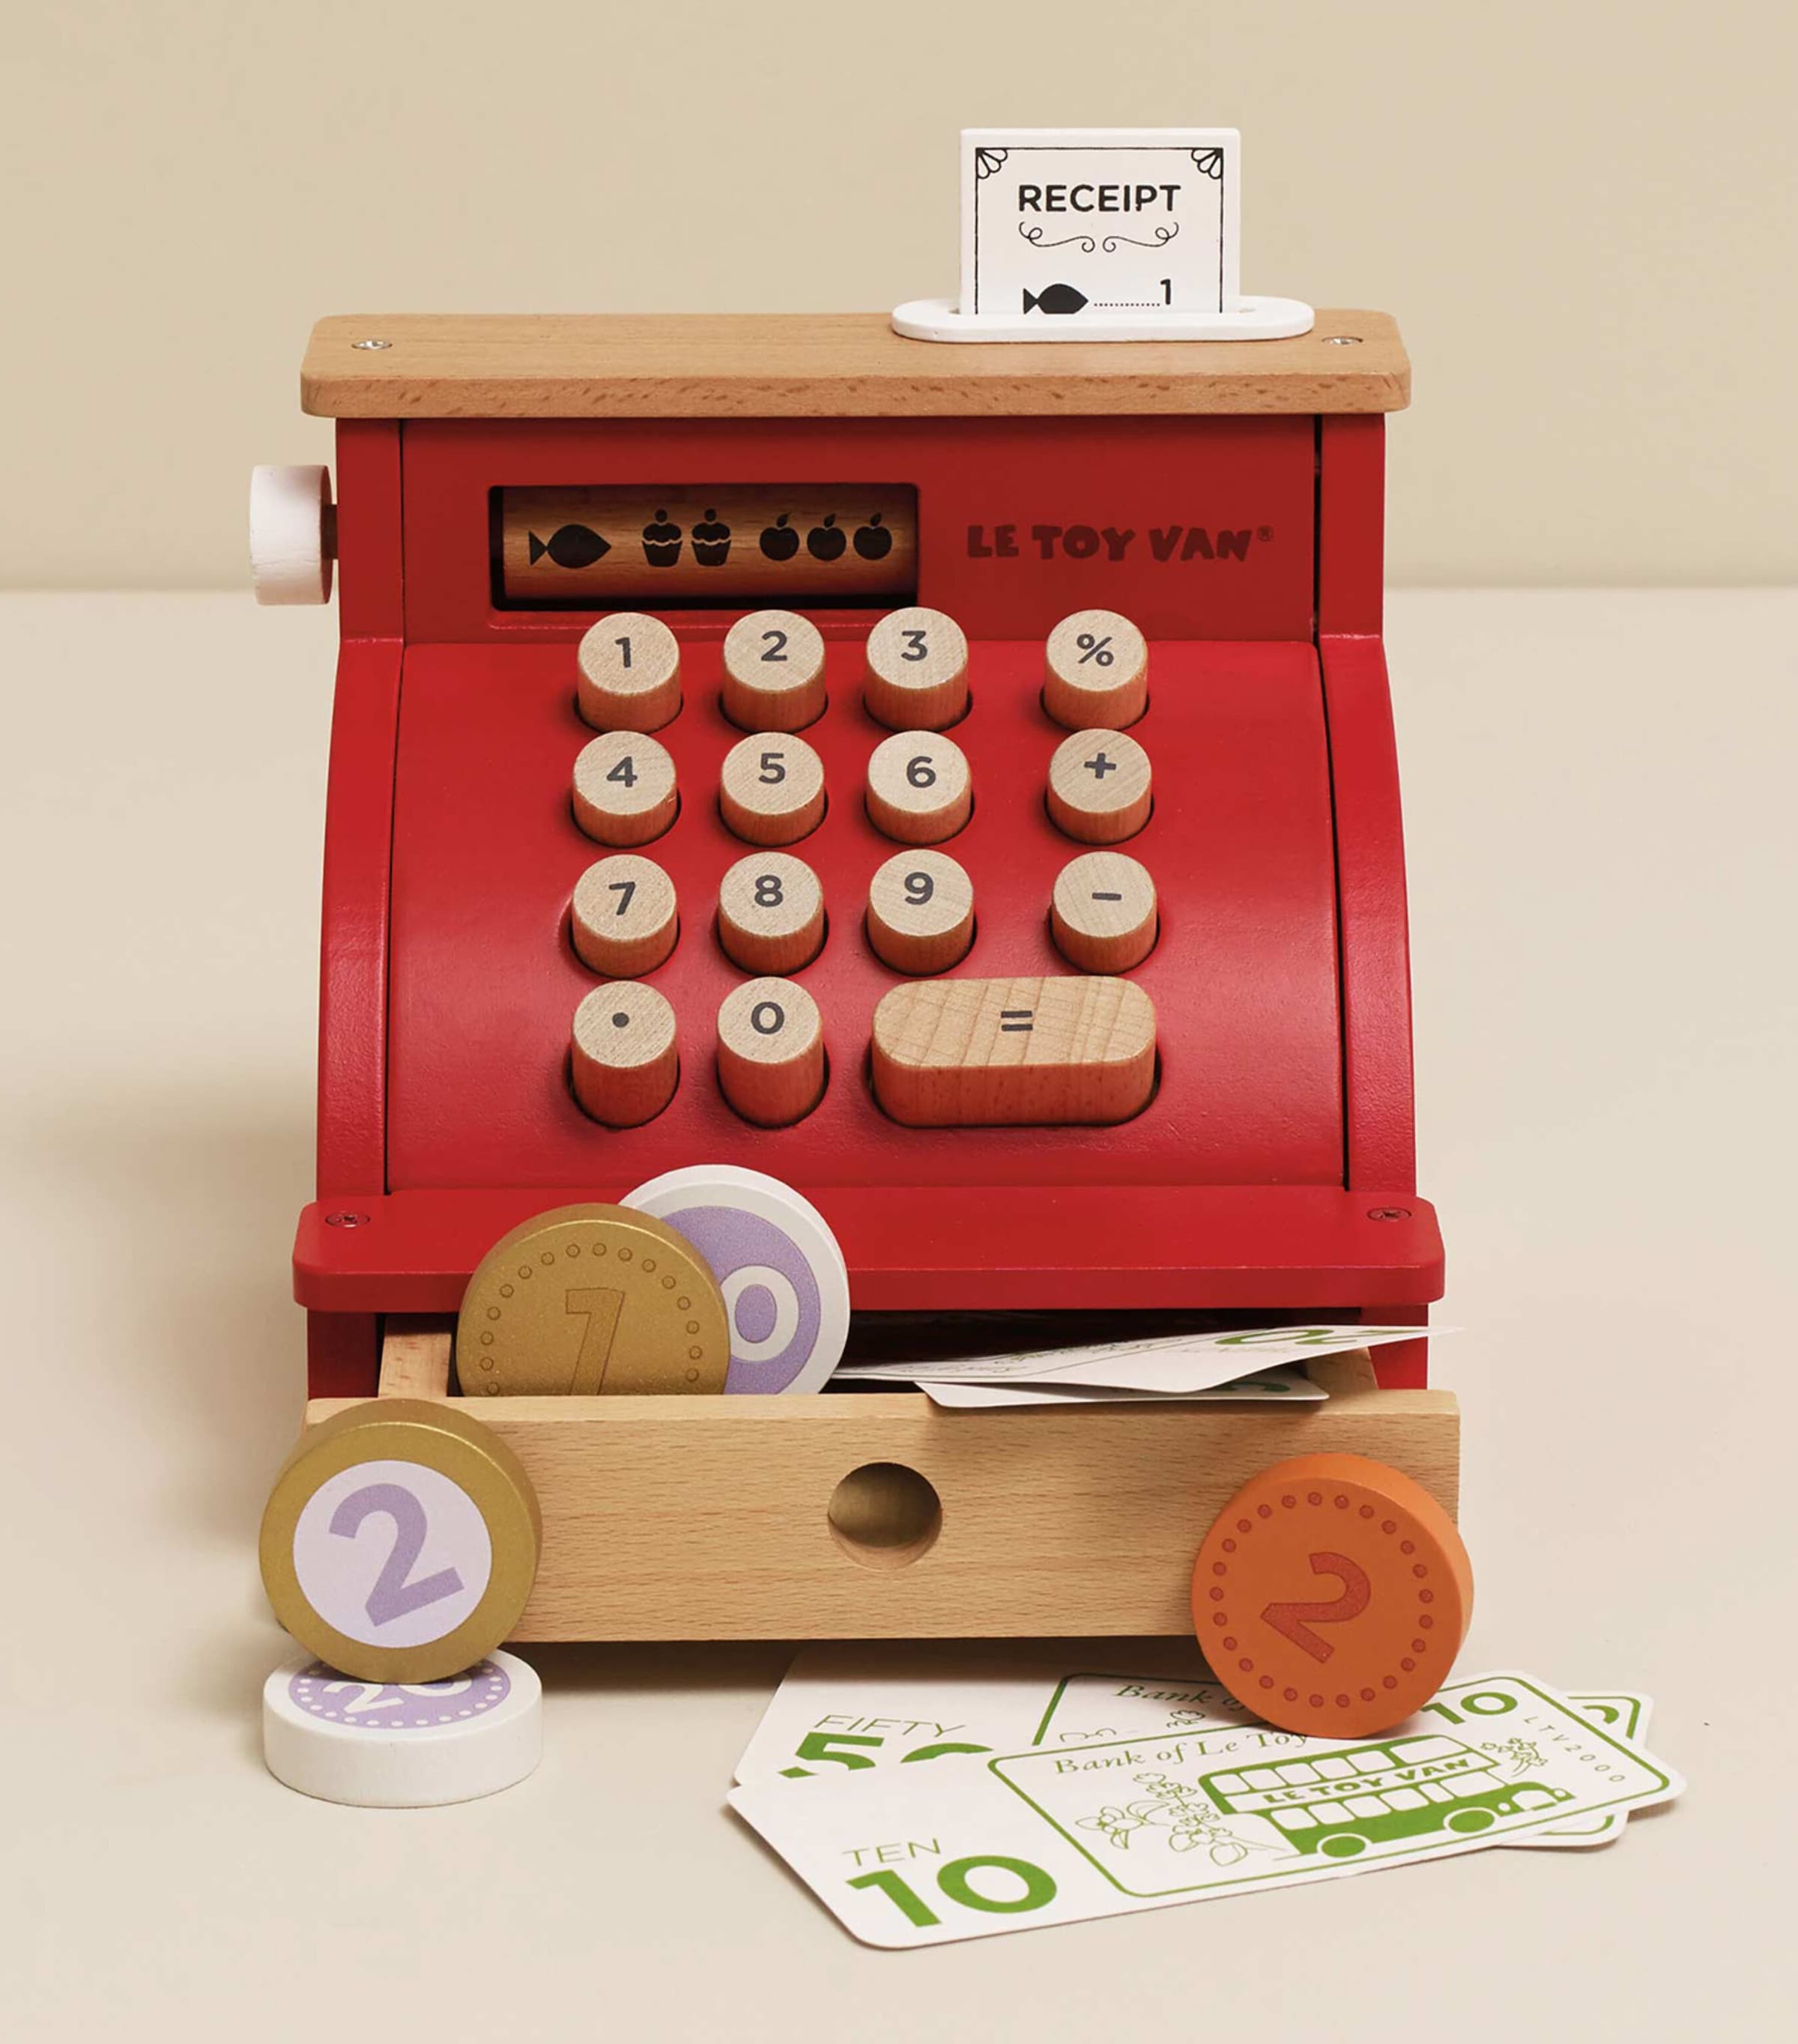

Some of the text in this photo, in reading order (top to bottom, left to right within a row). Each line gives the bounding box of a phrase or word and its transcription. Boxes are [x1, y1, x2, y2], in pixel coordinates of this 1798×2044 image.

[1018, 184, 1181, 212] RECEIPT
[1160, 279, 1172, 306] 1
[966, 524, 1019, 557] LE
[1031, 525, 1136, 561] TOY
[614, 637, 632, 668] 1
[761, 631, 789, 662] 2
[901, 631, 928, 662] 3
[1077, 634, 1114, 667] %
[606, 756, 638, 788] 4
[759, 753, 786, 784] 5
[906, 756, 936, 788] 6
[608, 882, 635, 915] 7
[754, 875, 784, 908] 8
[904, 873, 934, 906] 9
[751, 1001, 785, 1035] 0
[328, 1482, 465, 1628] 2
[1260, 1551, 1372, 1664] 2
[1115, 1684, 1214, 1705] Bank
[1420, 1691, 1519, 1725] 10
[813, 1714, 967, 1738] FIFTY
[777, 1732, 994, 1779] 5
[1055, 1732, 1310, 1774] Bank of Le Toy
[1262, 1758, 1470, 1804] LE TOY VAN
[841, 1837, 941, 1867] TEN
[844, 1855, 1058, 1929] 10
